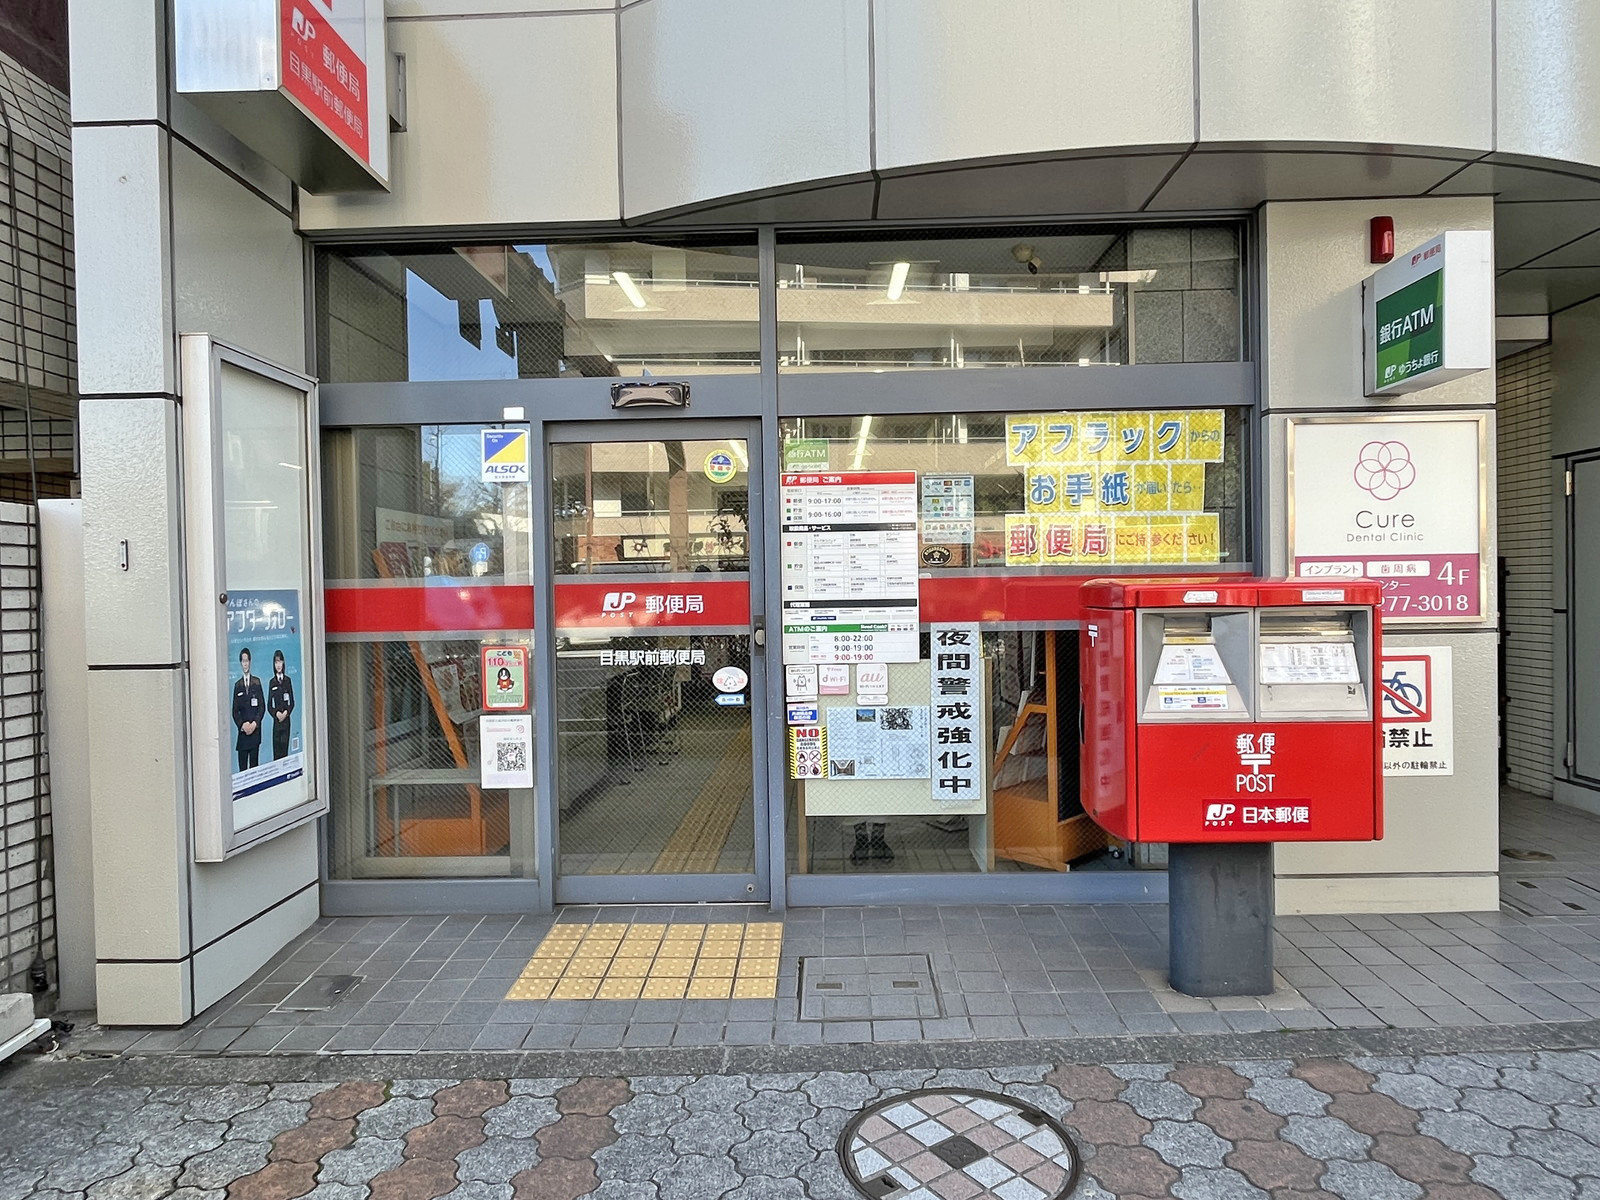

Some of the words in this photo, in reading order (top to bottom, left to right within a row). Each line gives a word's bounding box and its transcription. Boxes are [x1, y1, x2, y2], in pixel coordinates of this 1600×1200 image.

[322, 43, 361, 102] 郵便局
[289, 50, 364, 139] 目黒駅前郵便局
[1379, 303, 1434, 345] 銀行ATM
[1398, 350, 1439, 376] ゆうちょ銀行
[485, 465, 526, 474] ALSOK
[1355, 511, 1415, 529] Cure
[1346, 533, 1386, 543] Dental
[1390, 532, 1424, 542] Clinic
[1305, 565, 1359, 575] インプラント
[1381, 564, 1417, 574] 歯周病
[645, 595, 704, 615] 郵便局
[600, 649, 706, 666] 目黒駅前郵便局
[860, 672, 884, 683] au
[936, 628, 972, 794] 夜間警戒強化中
[796, 728, 820, 738] NO
[1382, 727, 1434, 748] 禁止
[1236, 732, 1276, 754] 郵便
[1383, 760, 1448, 770] 以外の駐輪禁止
[1236, 774, 1276, 792] POST
[1242, 806, 1309, 823] 日本郵便
